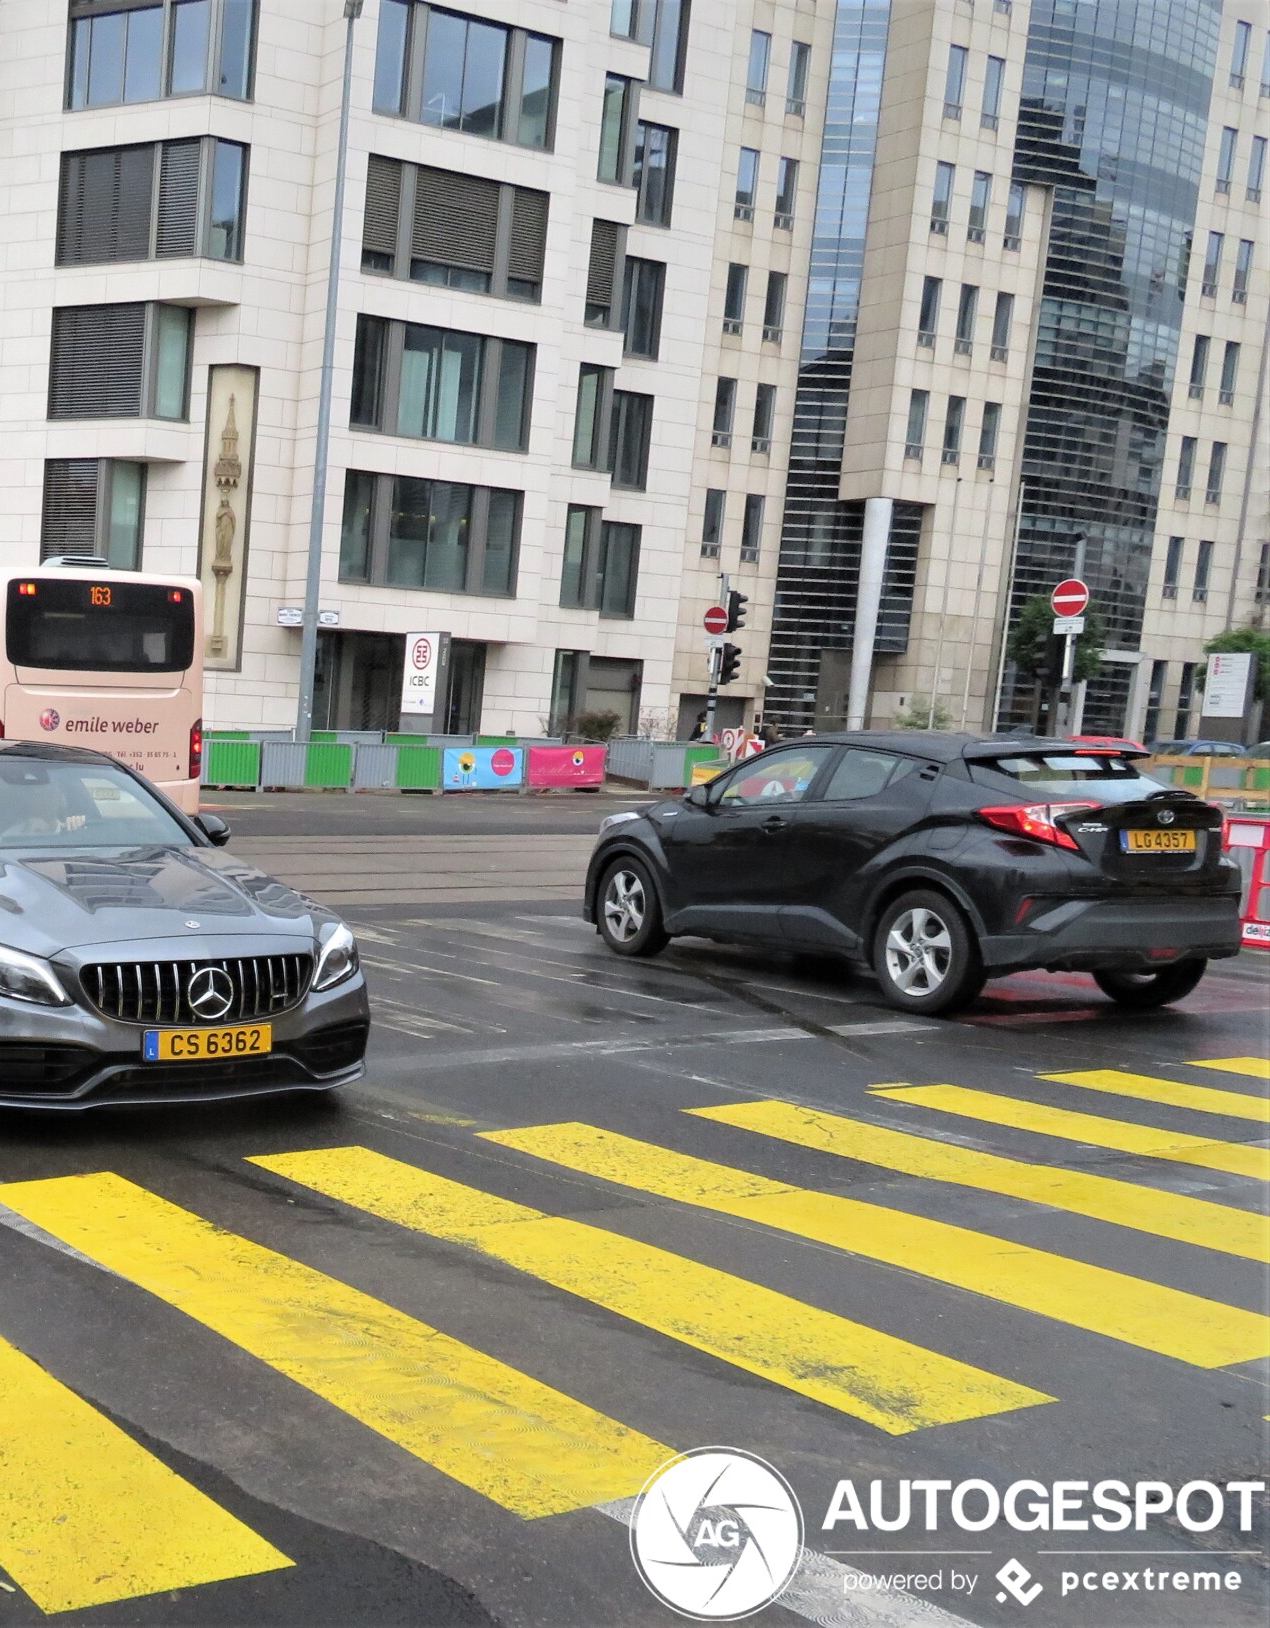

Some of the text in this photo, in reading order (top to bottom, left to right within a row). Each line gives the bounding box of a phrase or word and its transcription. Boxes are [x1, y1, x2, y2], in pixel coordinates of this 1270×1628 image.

[90, 586, 111, 605] 163
[409, 675, 430, 687] ICBC
[65, 716, 159, 734] emile weber
[1134, 832, 1151, 848] LG
[1154, 832, 1188, 848] 4357
[149, 1029, 261, 1056] L CS 6362
